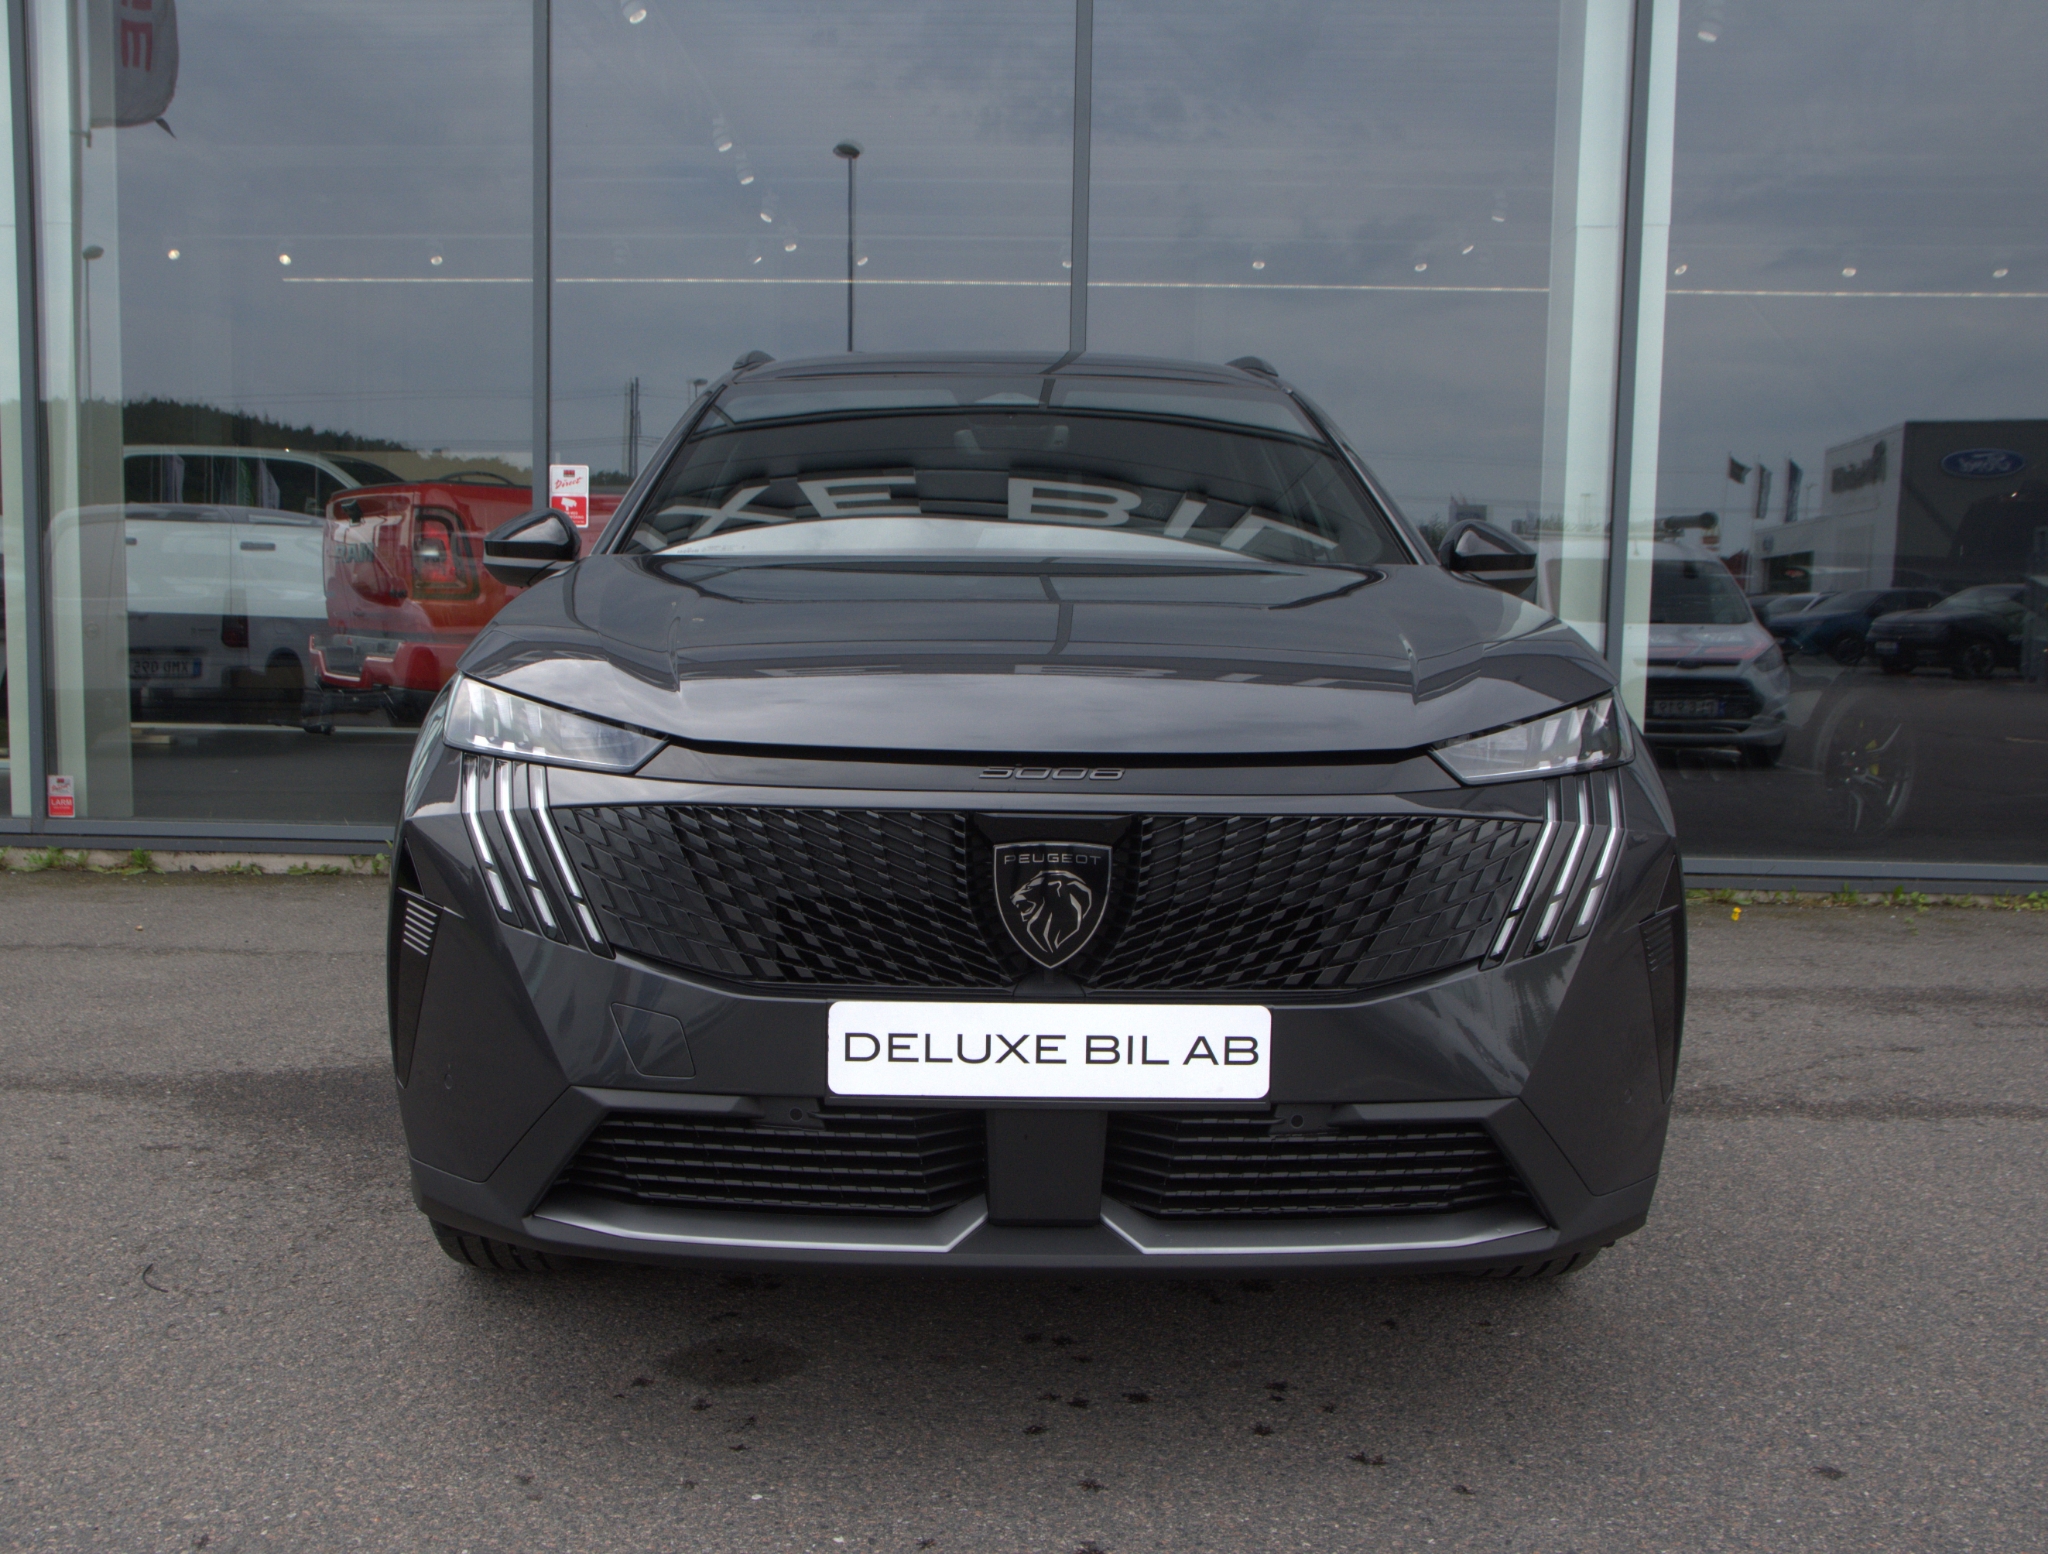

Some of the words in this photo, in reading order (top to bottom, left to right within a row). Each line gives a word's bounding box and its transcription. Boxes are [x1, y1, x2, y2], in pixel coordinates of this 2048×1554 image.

[335, 542, 375, 563] RAM
[978, 765, 1126, 781] 5008
[1003, 852, 1102, 866] PEUGEOT
[844, 1032, 1067, 1066] DELUXE
[1085, 1034, 1169, 1066] BIL
[1183, 1035, 1260, 1067] AB
